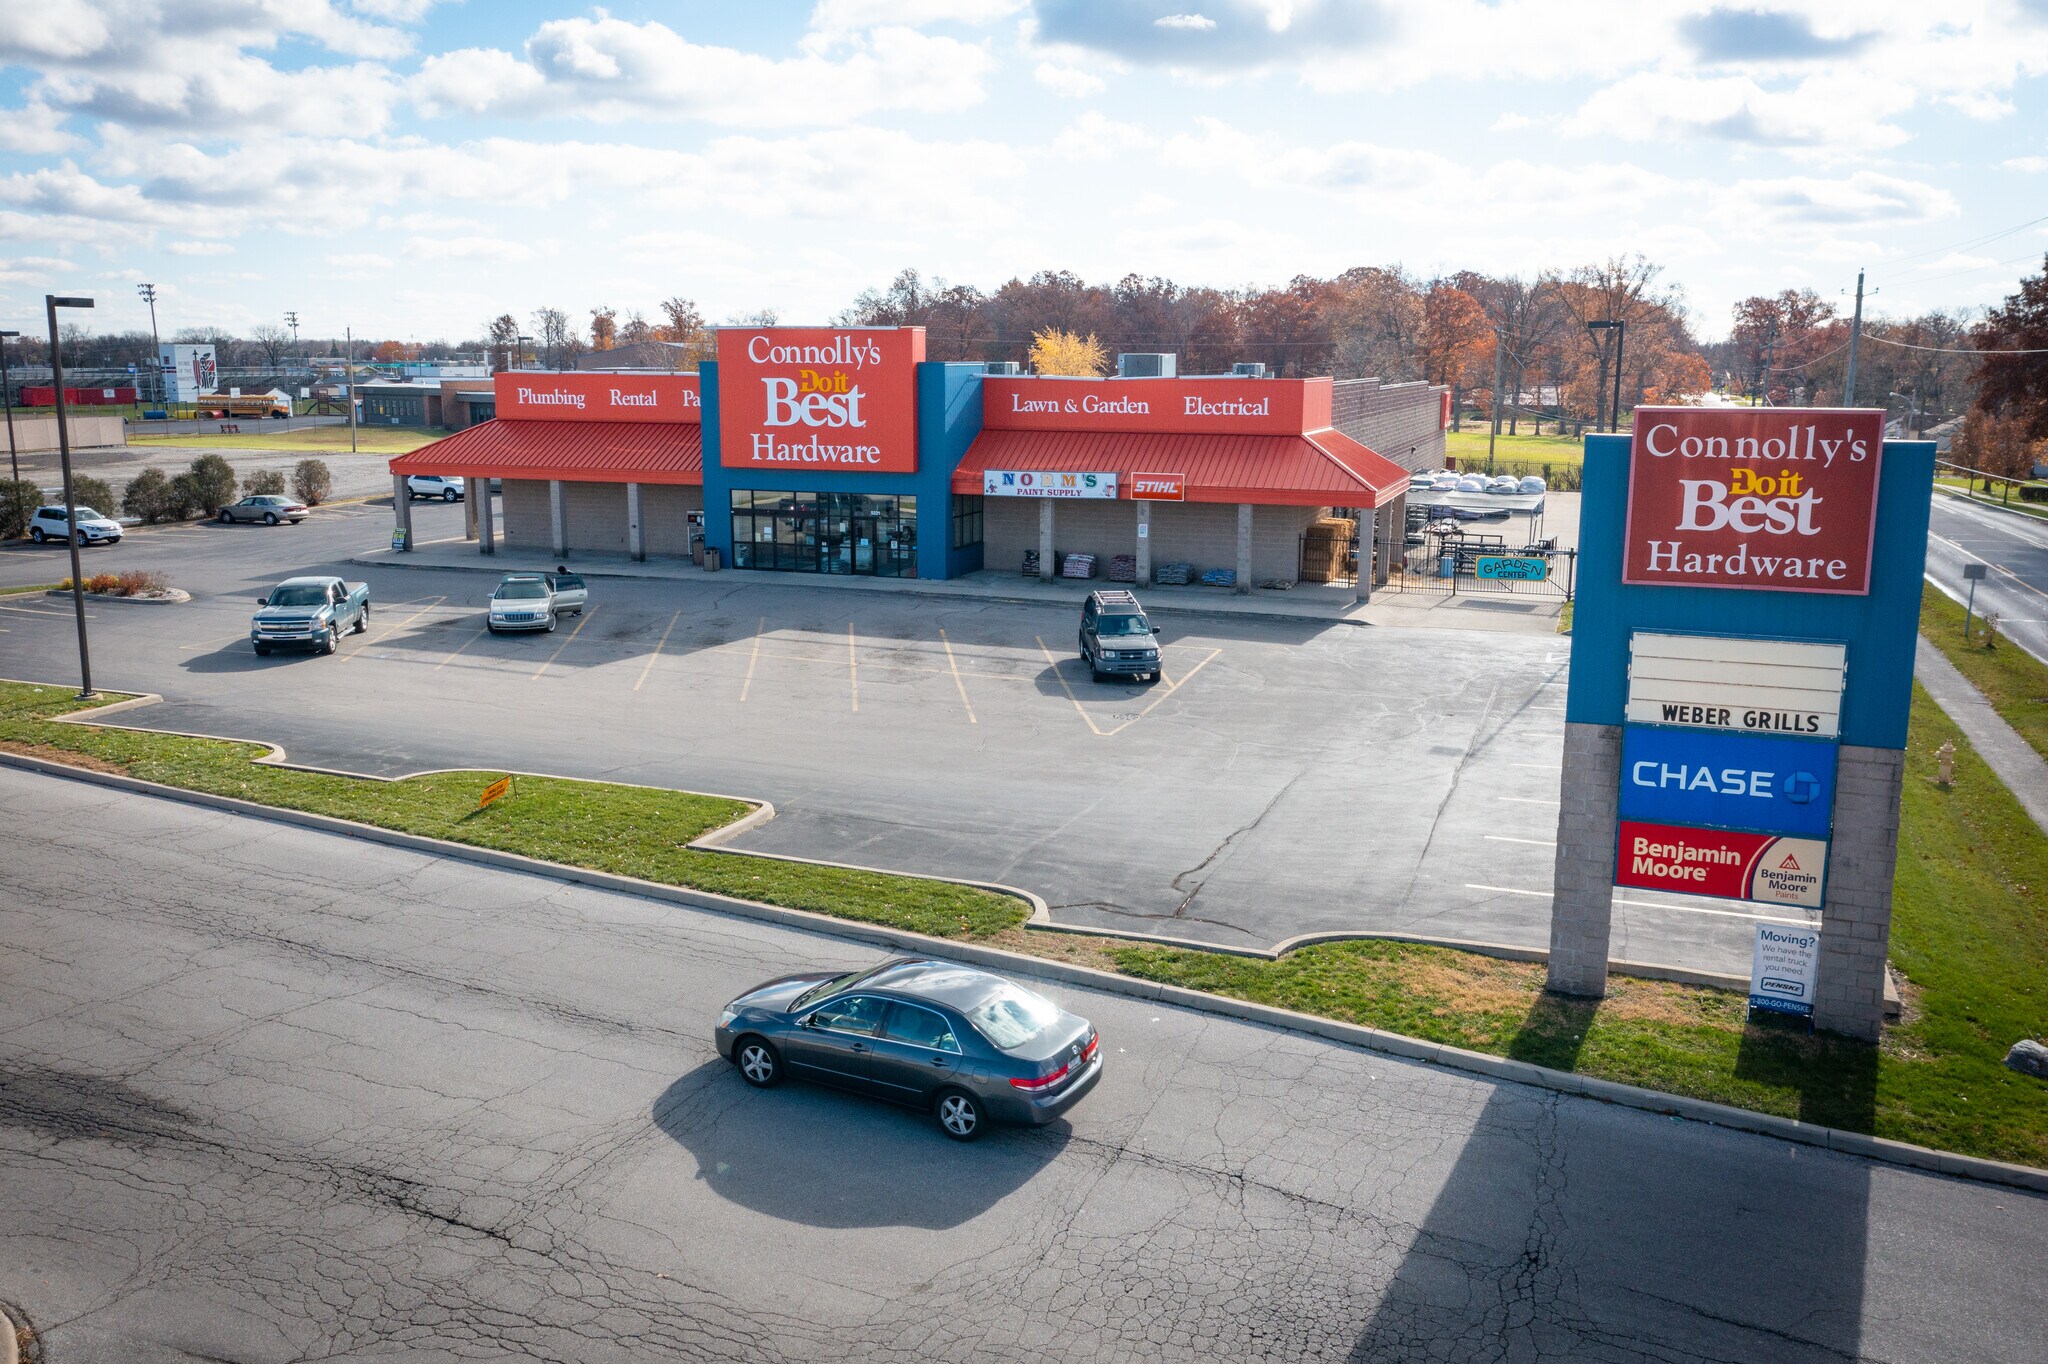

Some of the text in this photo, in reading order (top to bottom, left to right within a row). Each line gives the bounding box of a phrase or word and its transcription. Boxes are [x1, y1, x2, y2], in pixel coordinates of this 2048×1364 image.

[748, 335, 880, 370] Connolly's
[517, 388, 586, 409] Plumbing
[609, 389, 657, 406] Rental
[761, 377, 866, 428] Best
[1011, 393, 1269, 416] Lawn & Garden Electrical
[750, 433, 880, 464] Hardware
[1646, 424, 1867, 468] Connolly's
[1002, 473, 1097, 488] NORM'S
[1134, 481, 1179, 493] STIHL
[1017, 488, 1082, 497] PAINT SUPPLY
[1675, 479, 1823, 536] Best
[1483, 559, 1543, 576] GARDEN
[1647, 540, 1847, 580] Hardware
[1497, 571, 1527, 579] CENTER
[1662, 704, 1820, 732] WEBER GRILLS
[1632, 760, 1775, 798] CHASE
[1633, 836, 1741, 866] Benjamin
[1631, 856, 1707, 881] Moore
[1761, 868, 1817, 884] Benjamin
[1768, 880, 1808, 893] Moore
[1775, 890, 1798, 900] Paints
[1760, 930, 1816, 948] Moving?
[1762, 944, 1812, 959] We have the
[1763, 954, 1808, 967] rental truck
[1764, 964, 1780, 972] you
[1764, 981, 1801, 992] PENSKE
[1752, 997, 1810, 1013] 1-800-GO-PENSKE
